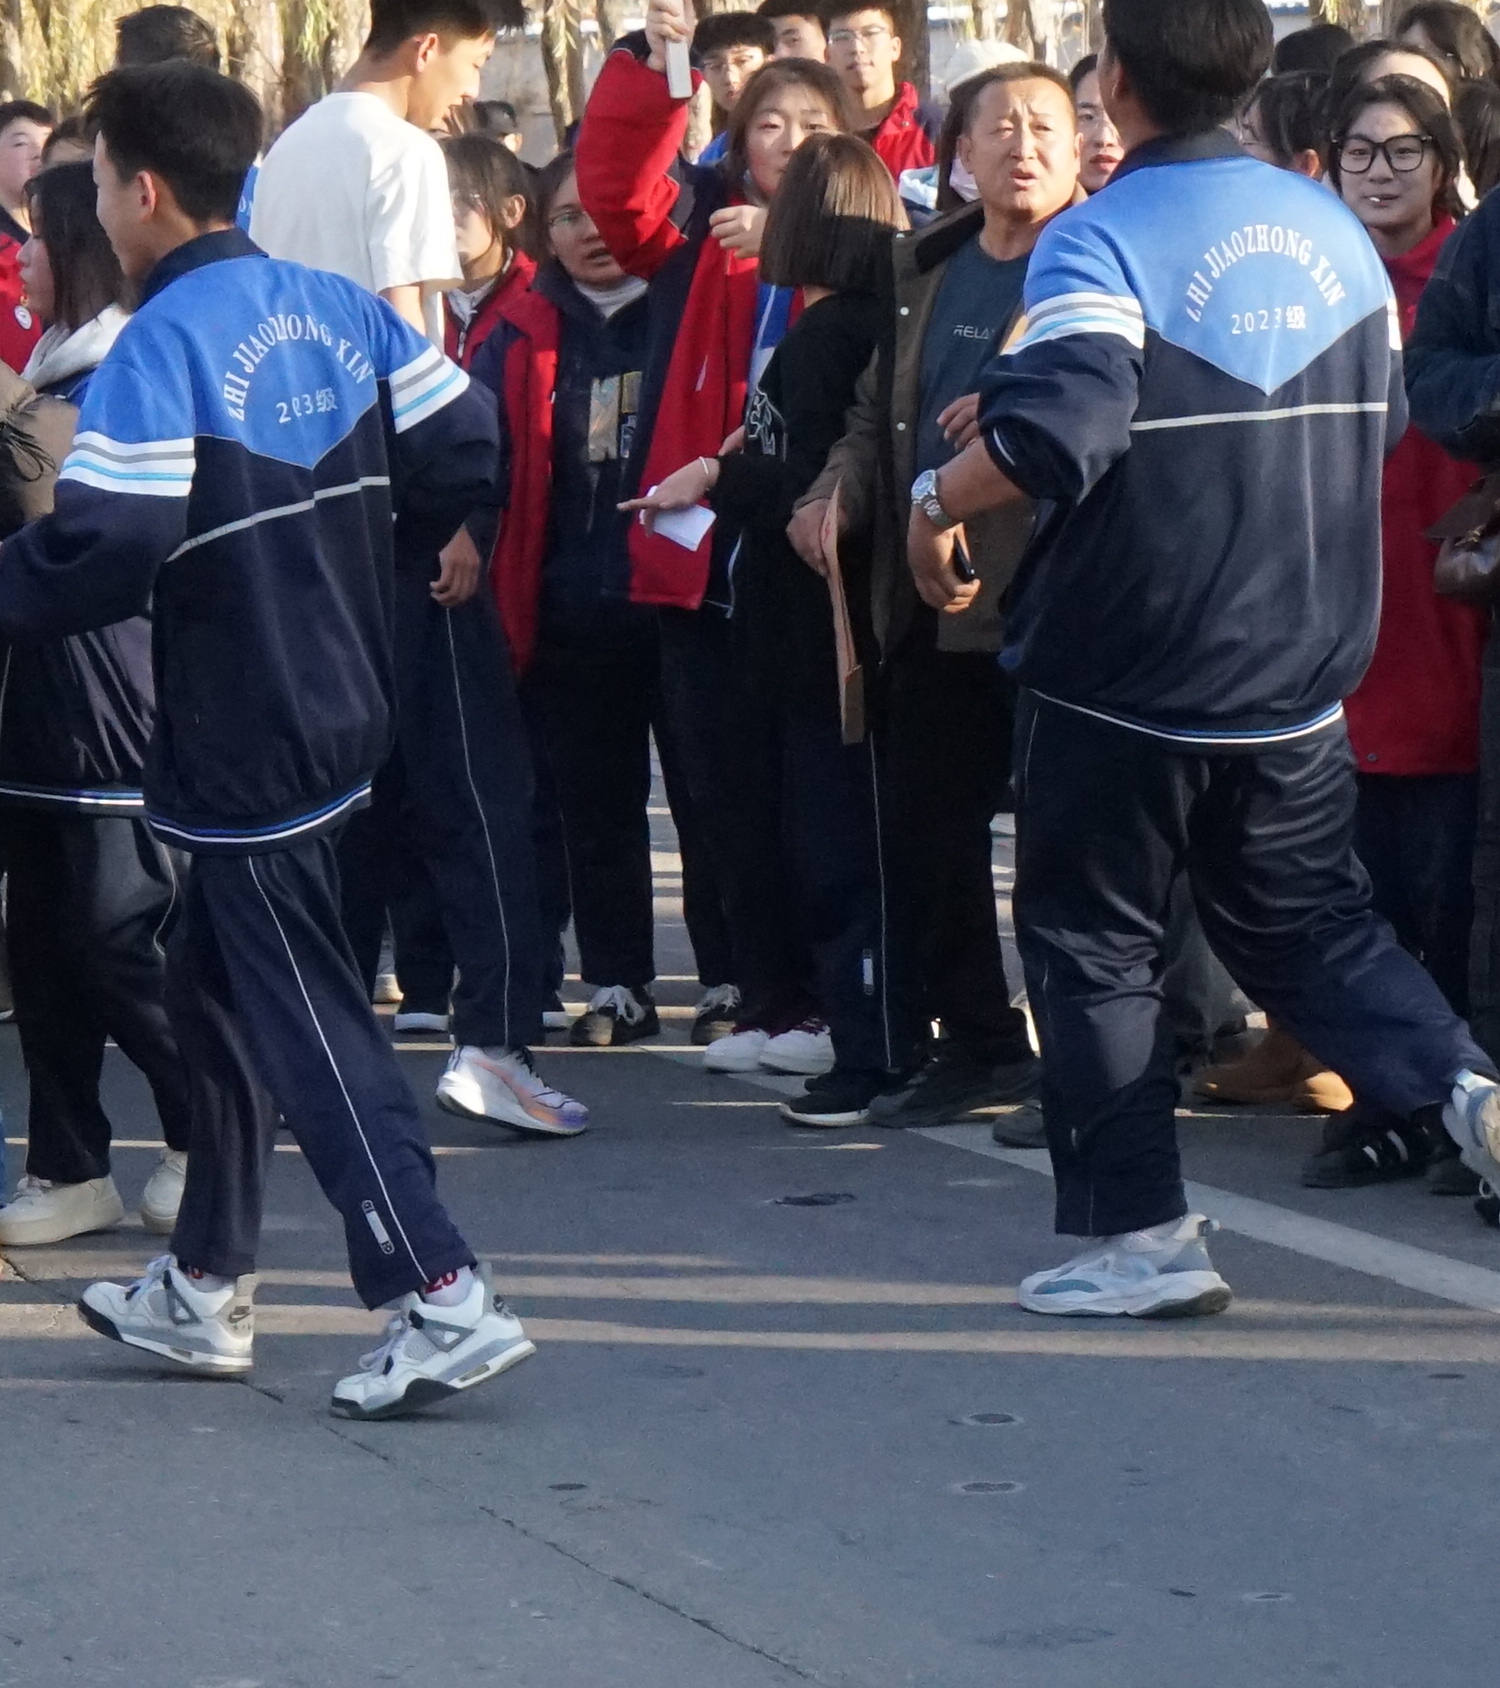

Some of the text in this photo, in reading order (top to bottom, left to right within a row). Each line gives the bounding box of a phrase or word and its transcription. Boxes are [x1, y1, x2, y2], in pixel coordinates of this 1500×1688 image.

[1310, 254, 1346, 307] XIN
[953, 324, 995, 340] RELA
[1231, 305, 1307, 335] 2023级
[335, 338, 375, 384] XIN
